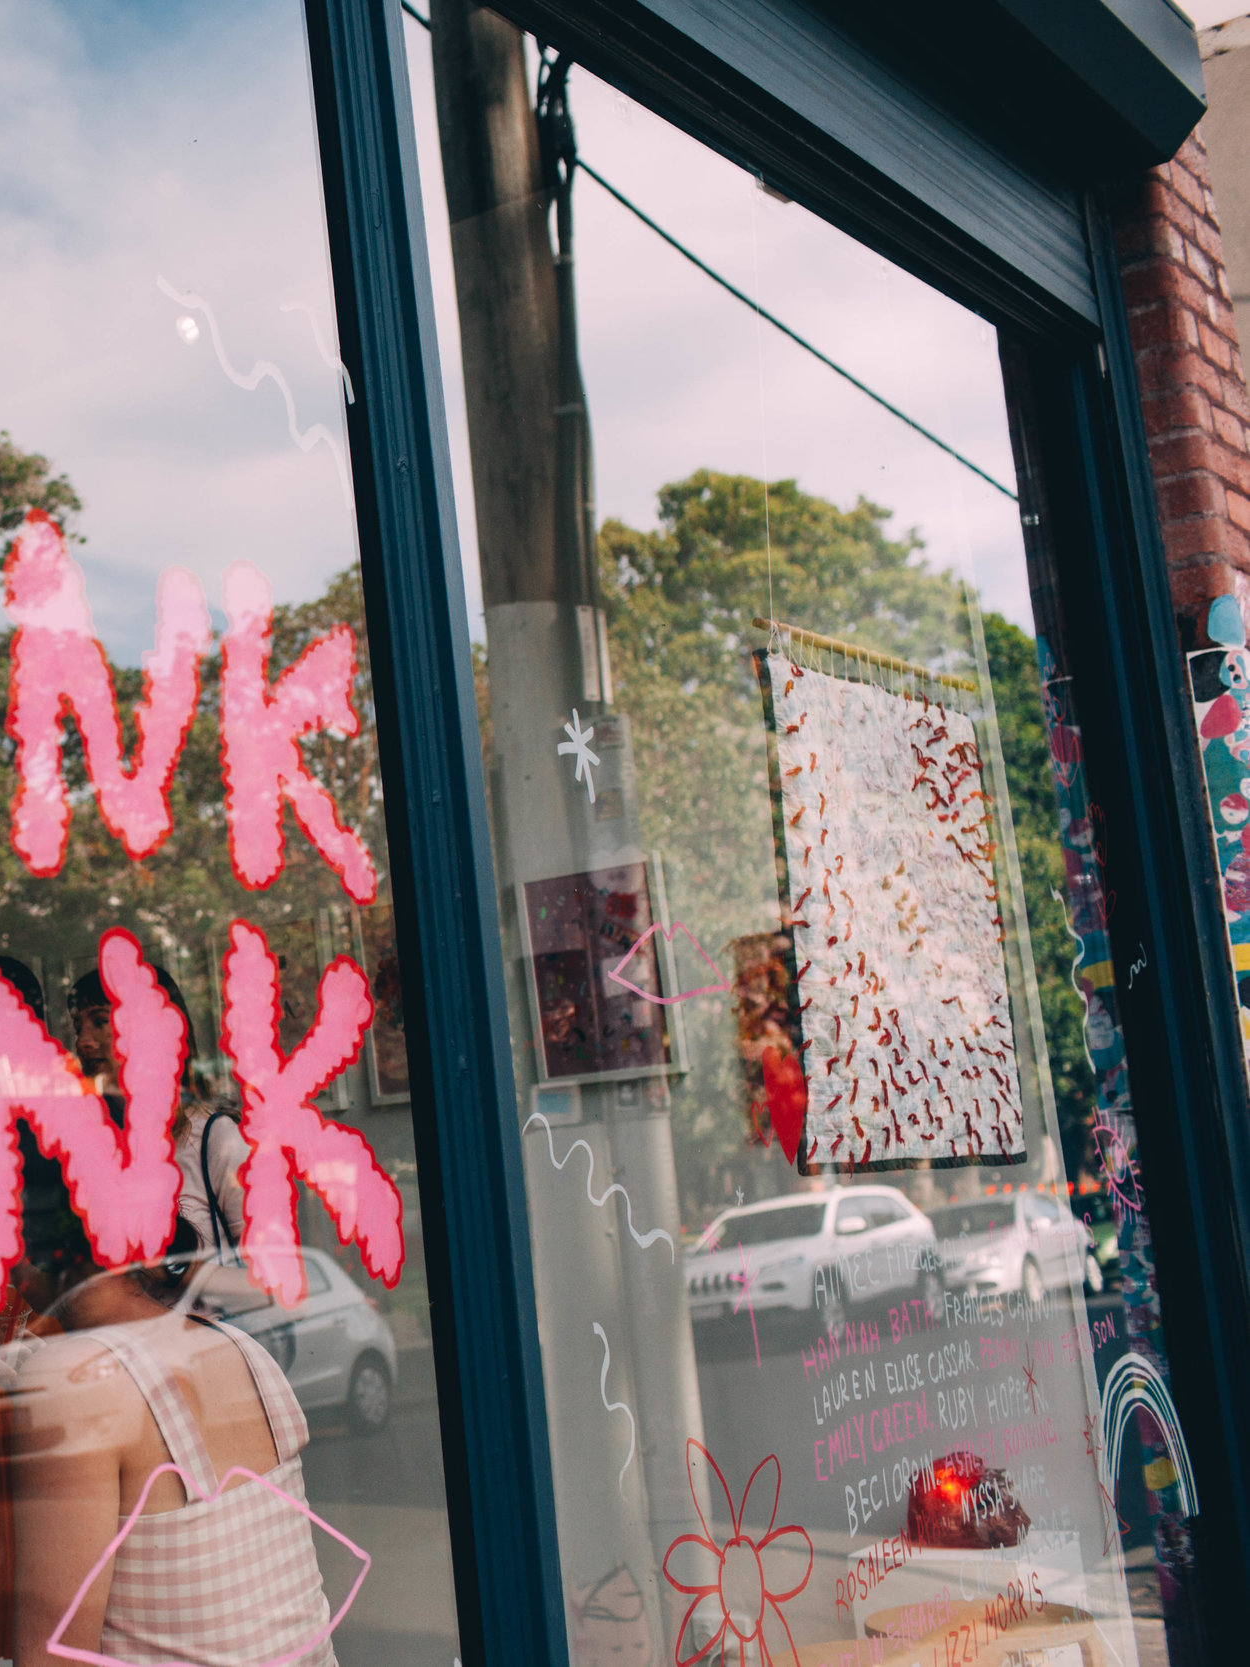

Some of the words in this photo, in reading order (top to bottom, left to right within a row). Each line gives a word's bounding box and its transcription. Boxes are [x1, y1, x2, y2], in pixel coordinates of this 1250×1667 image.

[814, 1248, 880, 1310] AIMEE
[802, 1320, 881, 1383] HANNAH
[943, 1289, 1004, 1329] FRANCES
[813, 1361, 876, 1425] LAUREN
[884, 1353, 925, 1395] ELISE
[814, 1412, 868, 1481] EMILY
[937, 1384, 978, 1430] RUBY
[944, 1430, 996, 1478] ASHLEY
[835, 1526, 912, 1623] ROSALEEN
[960, 1477, 1004, 1528] NYSSA
[985, 1571, 1048, 1646] MORRIS.
